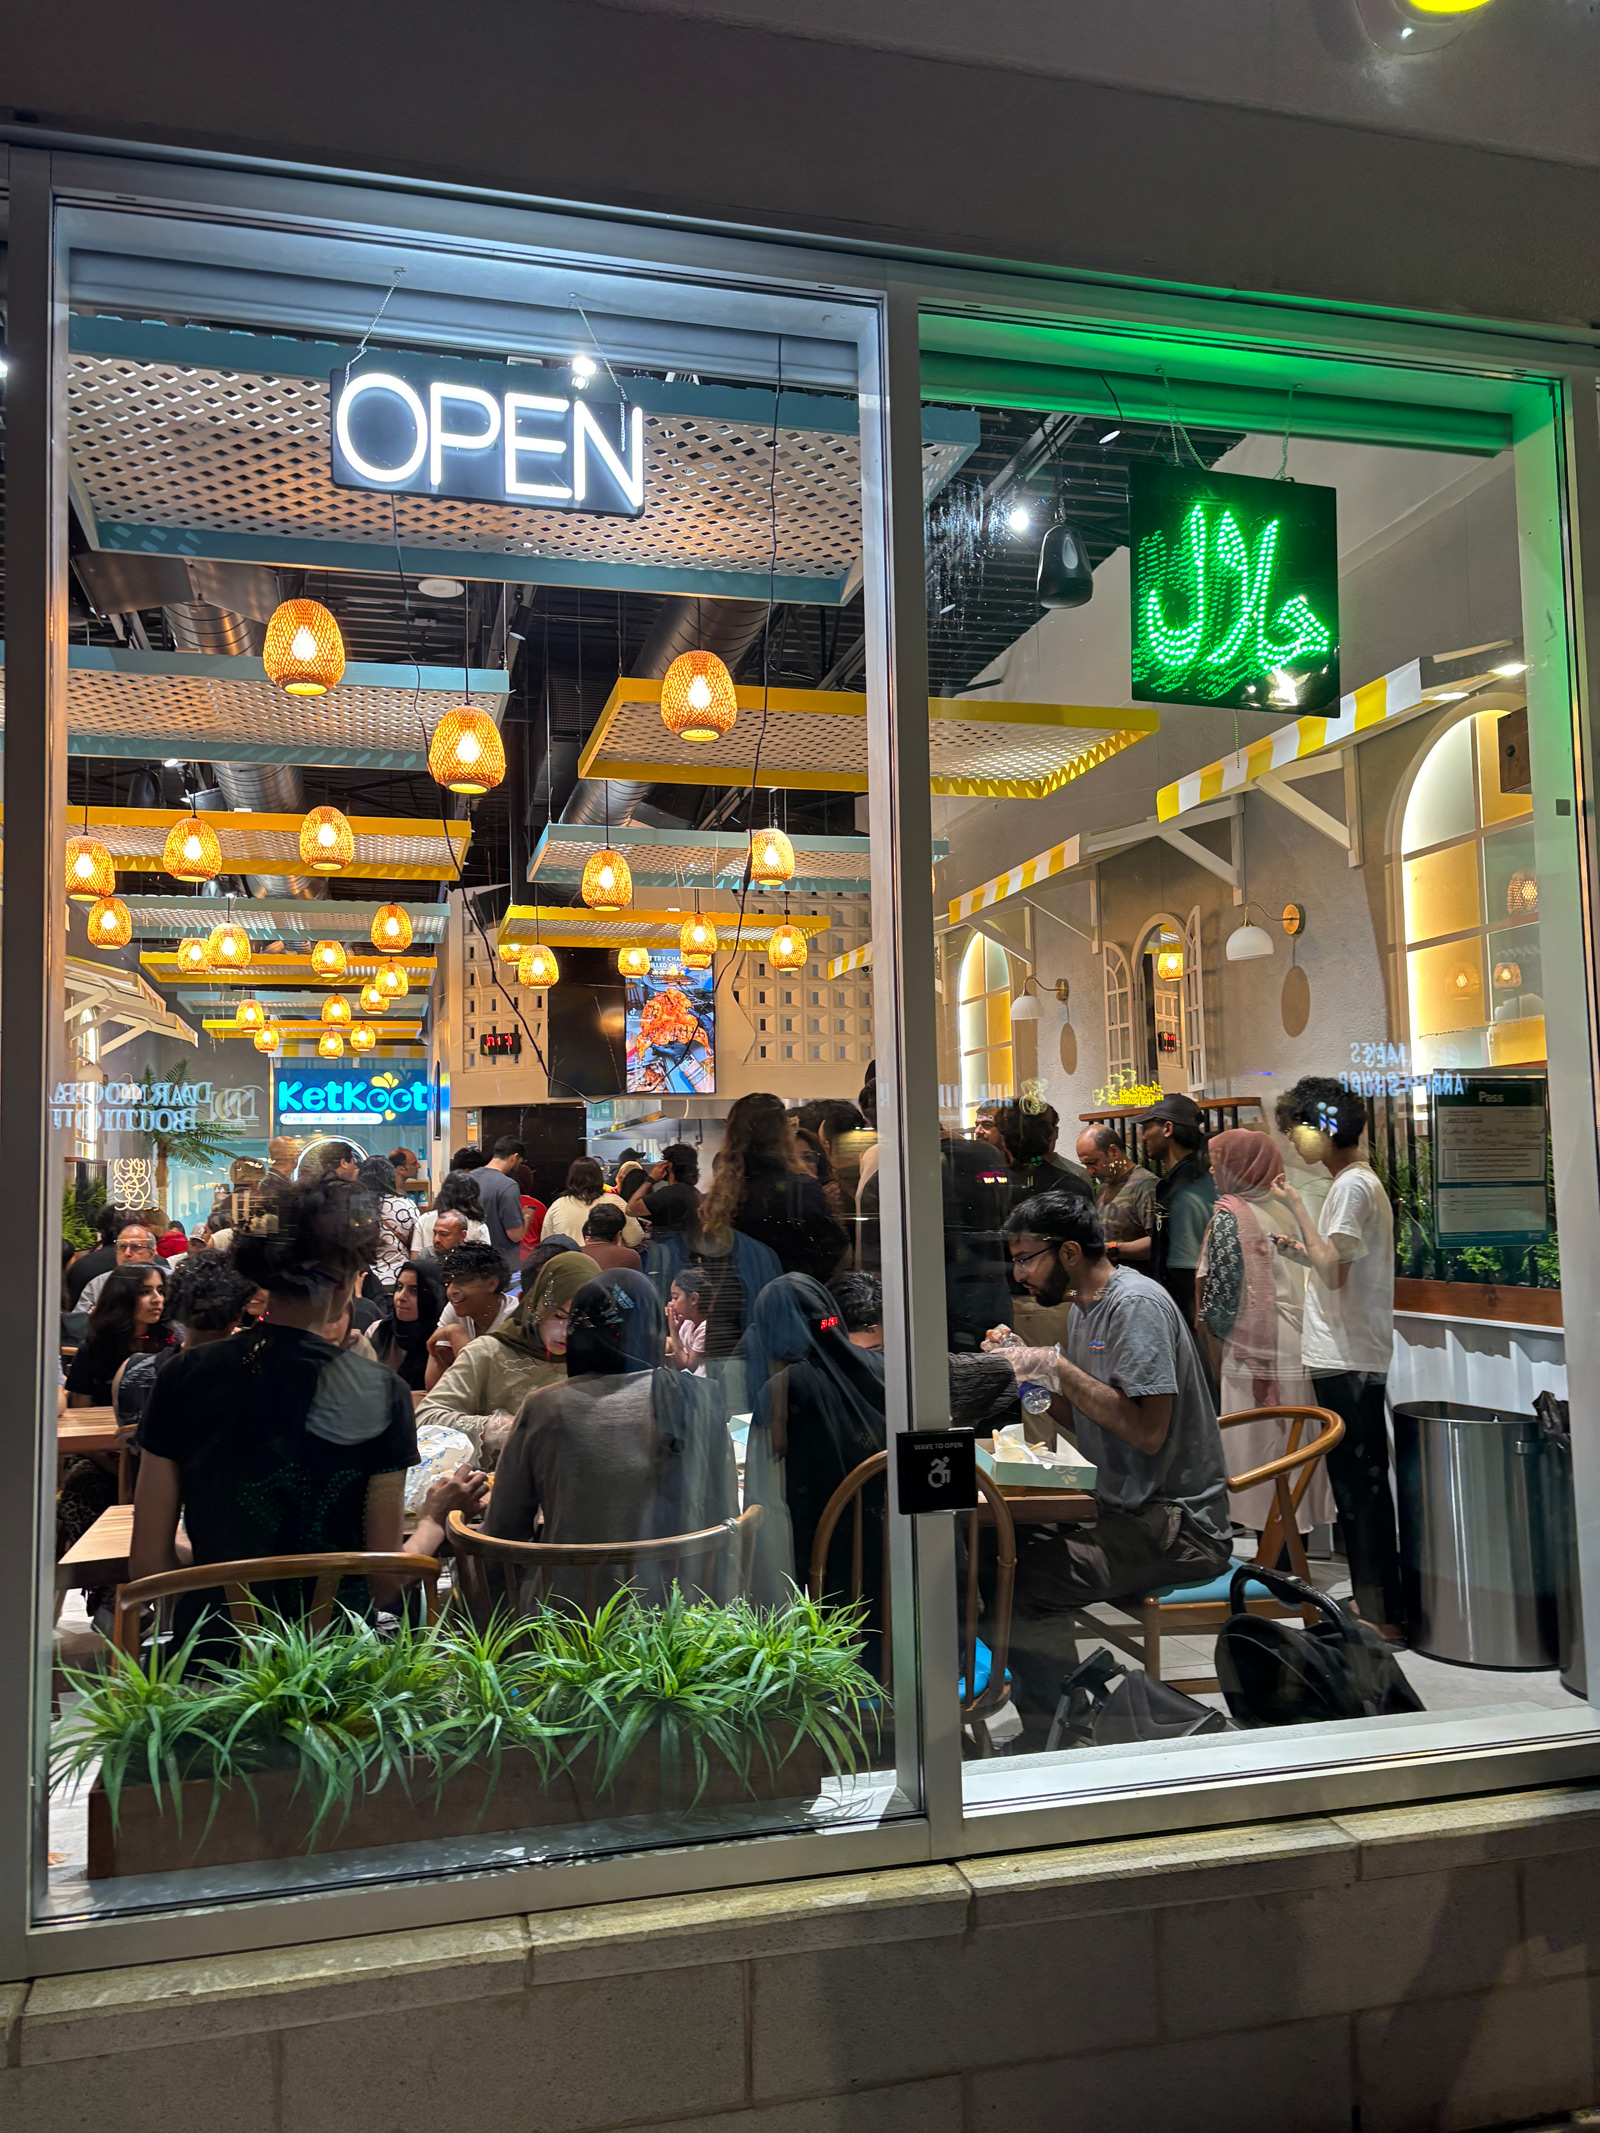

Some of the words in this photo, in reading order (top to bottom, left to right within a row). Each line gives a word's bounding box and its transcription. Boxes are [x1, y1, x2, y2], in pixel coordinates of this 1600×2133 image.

[336, 372, 644, 508] OPEN
[1146, 503, 1331, 671] حلال
[278, 1081, 428, 1112] KetKoot
[1478, 1091, 1504, 1103] Pass
